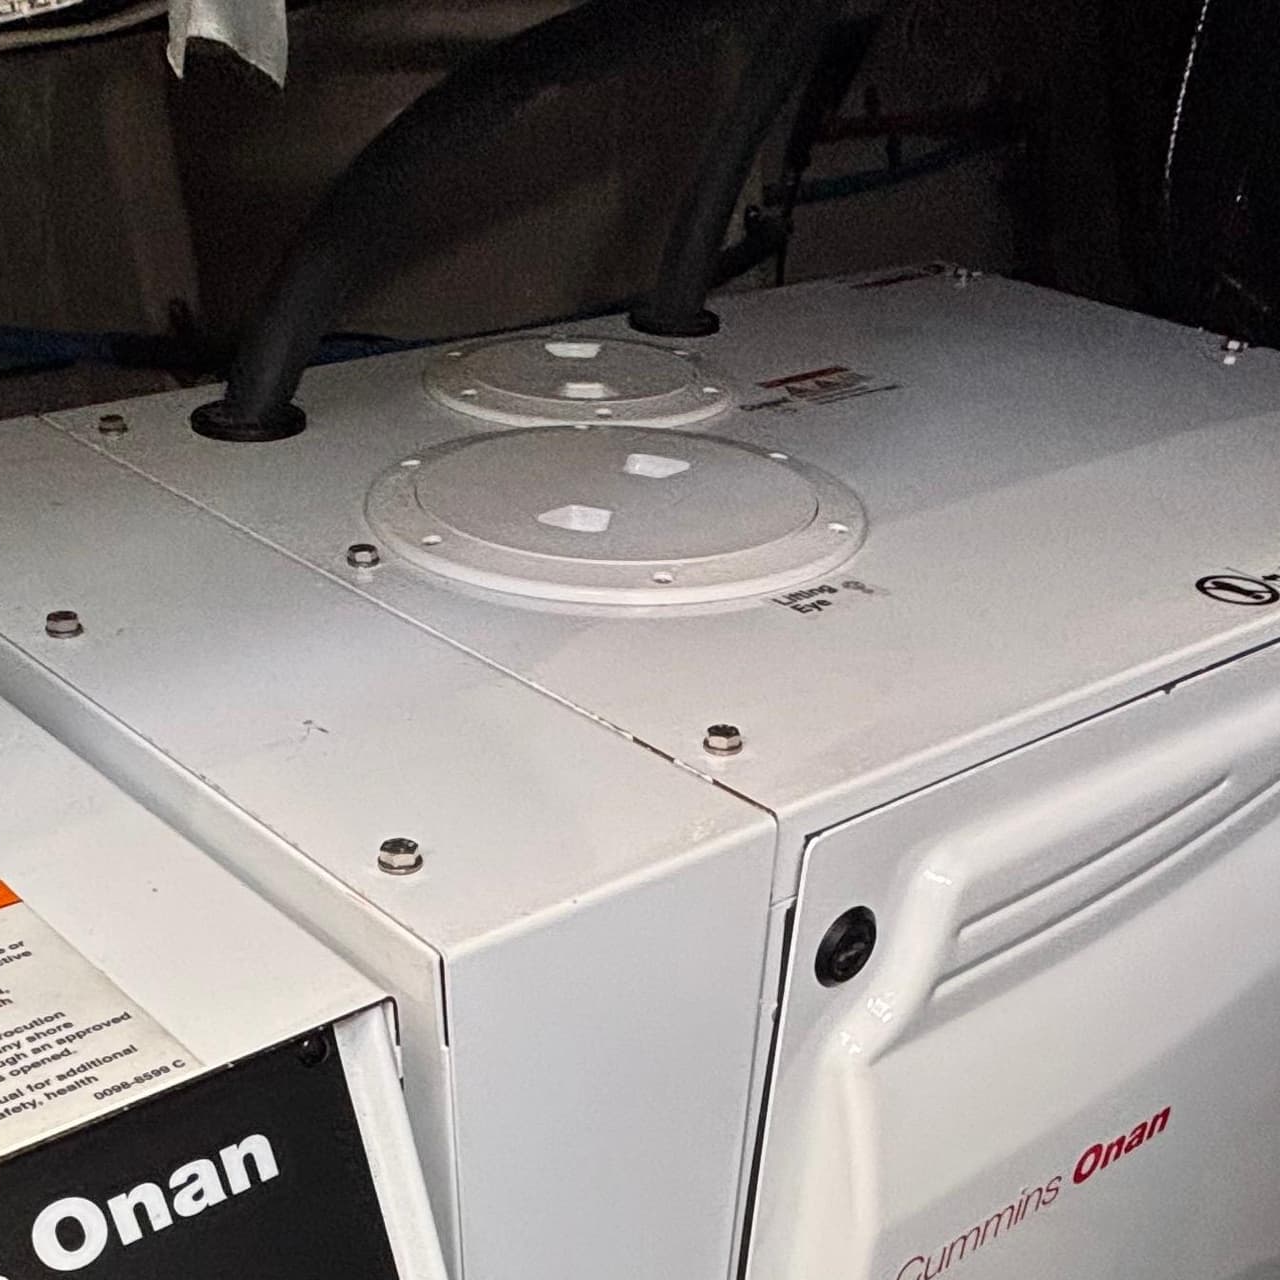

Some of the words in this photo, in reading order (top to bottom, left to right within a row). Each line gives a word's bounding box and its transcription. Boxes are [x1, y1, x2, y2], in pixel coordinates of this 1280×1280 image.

[771, 584, 838, 606] Lifting
[790, 599, 832, 614] Eye
[7, 940, 24, 950] or
[24, 1021, 74, 1043] shore
[30, 1042, 53, 1054] an
[54, 1011, 132, 1045] approved
[8, 1047, 78, 1076] opened.
[25, 1077, 51, 1092] for
[55, 1043, 138, 1081] additional
[171, 1058, 186, 1068] C
[42, 1075, 99, 1100] health
[1072, 1106, 1171, 1185] Onan
[31, 1133, 280, 1271] Onan
